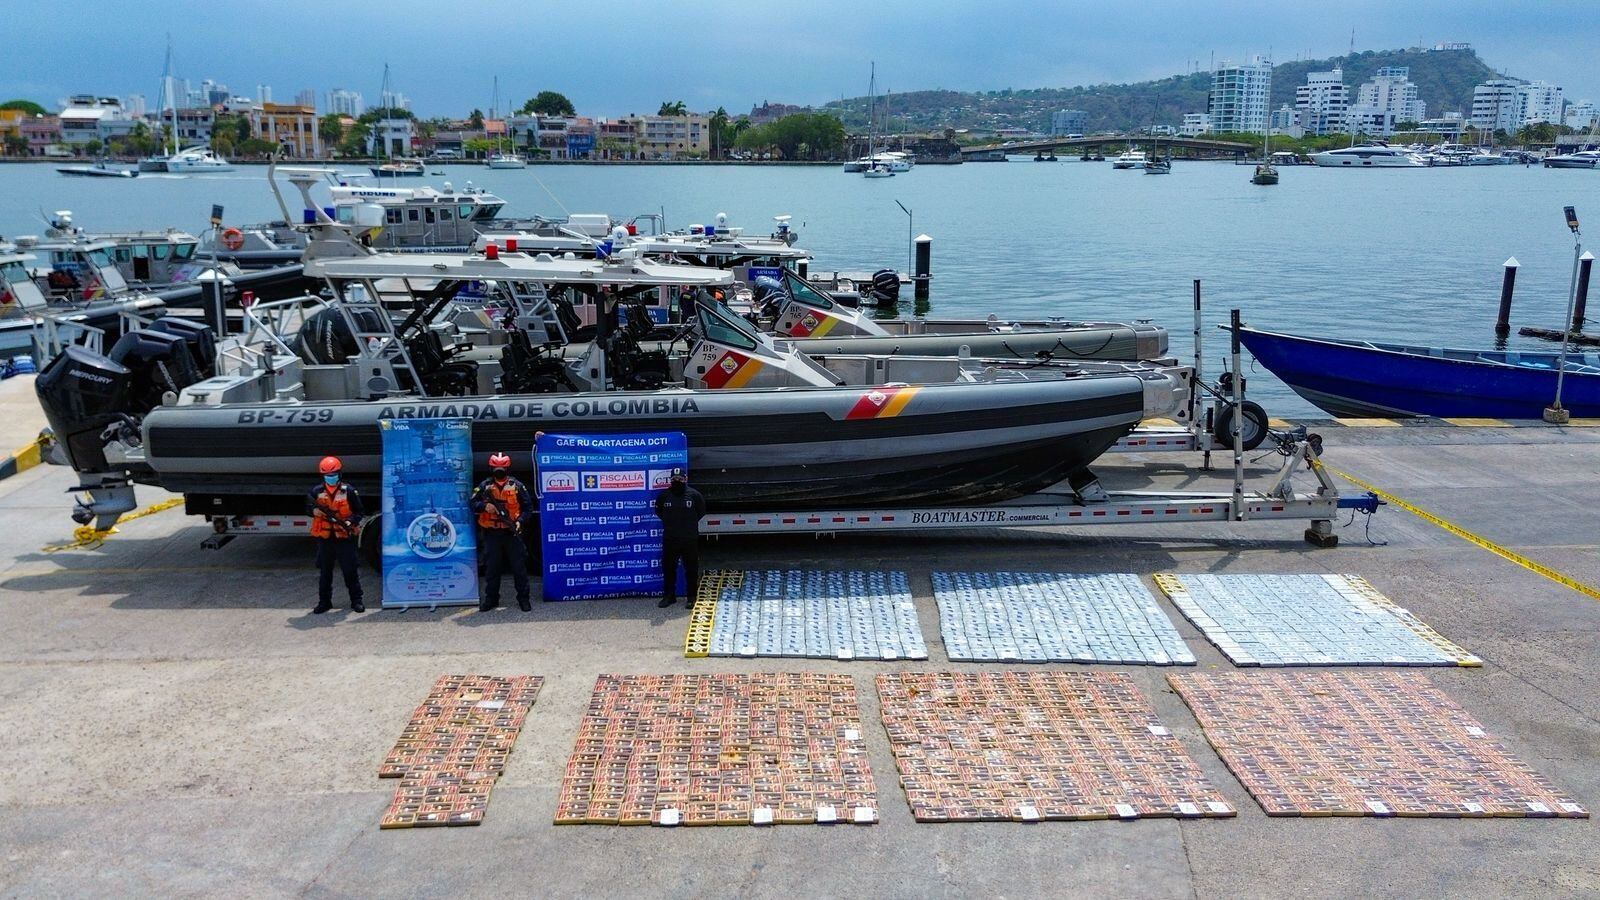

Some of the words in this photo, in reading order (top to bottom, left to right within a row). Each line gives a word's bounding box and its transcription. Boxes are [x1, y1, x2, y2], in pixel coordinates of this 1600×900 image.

[702, 344, 718, 352] BP-
[702, 353, 717, 361] 759
[69, 368, 113, 384] MERCURY
[376, 403, 499, 420] ARMADA
[508, 402, 544, 418] DE
[551, 397, 700, 417] COLOMBIA
[237, 409, 335, 424] BP-759
[556, 439, 575, 447] GAE
[577, 439, 590, 447] RU
[591, 438, 646, 447] CARTAGENA
[648, 437, 668, 446] DCTI
[600, 473, 644, 482] FISCALÍA
[911, 510, 1007, 524] BOATMASTER
